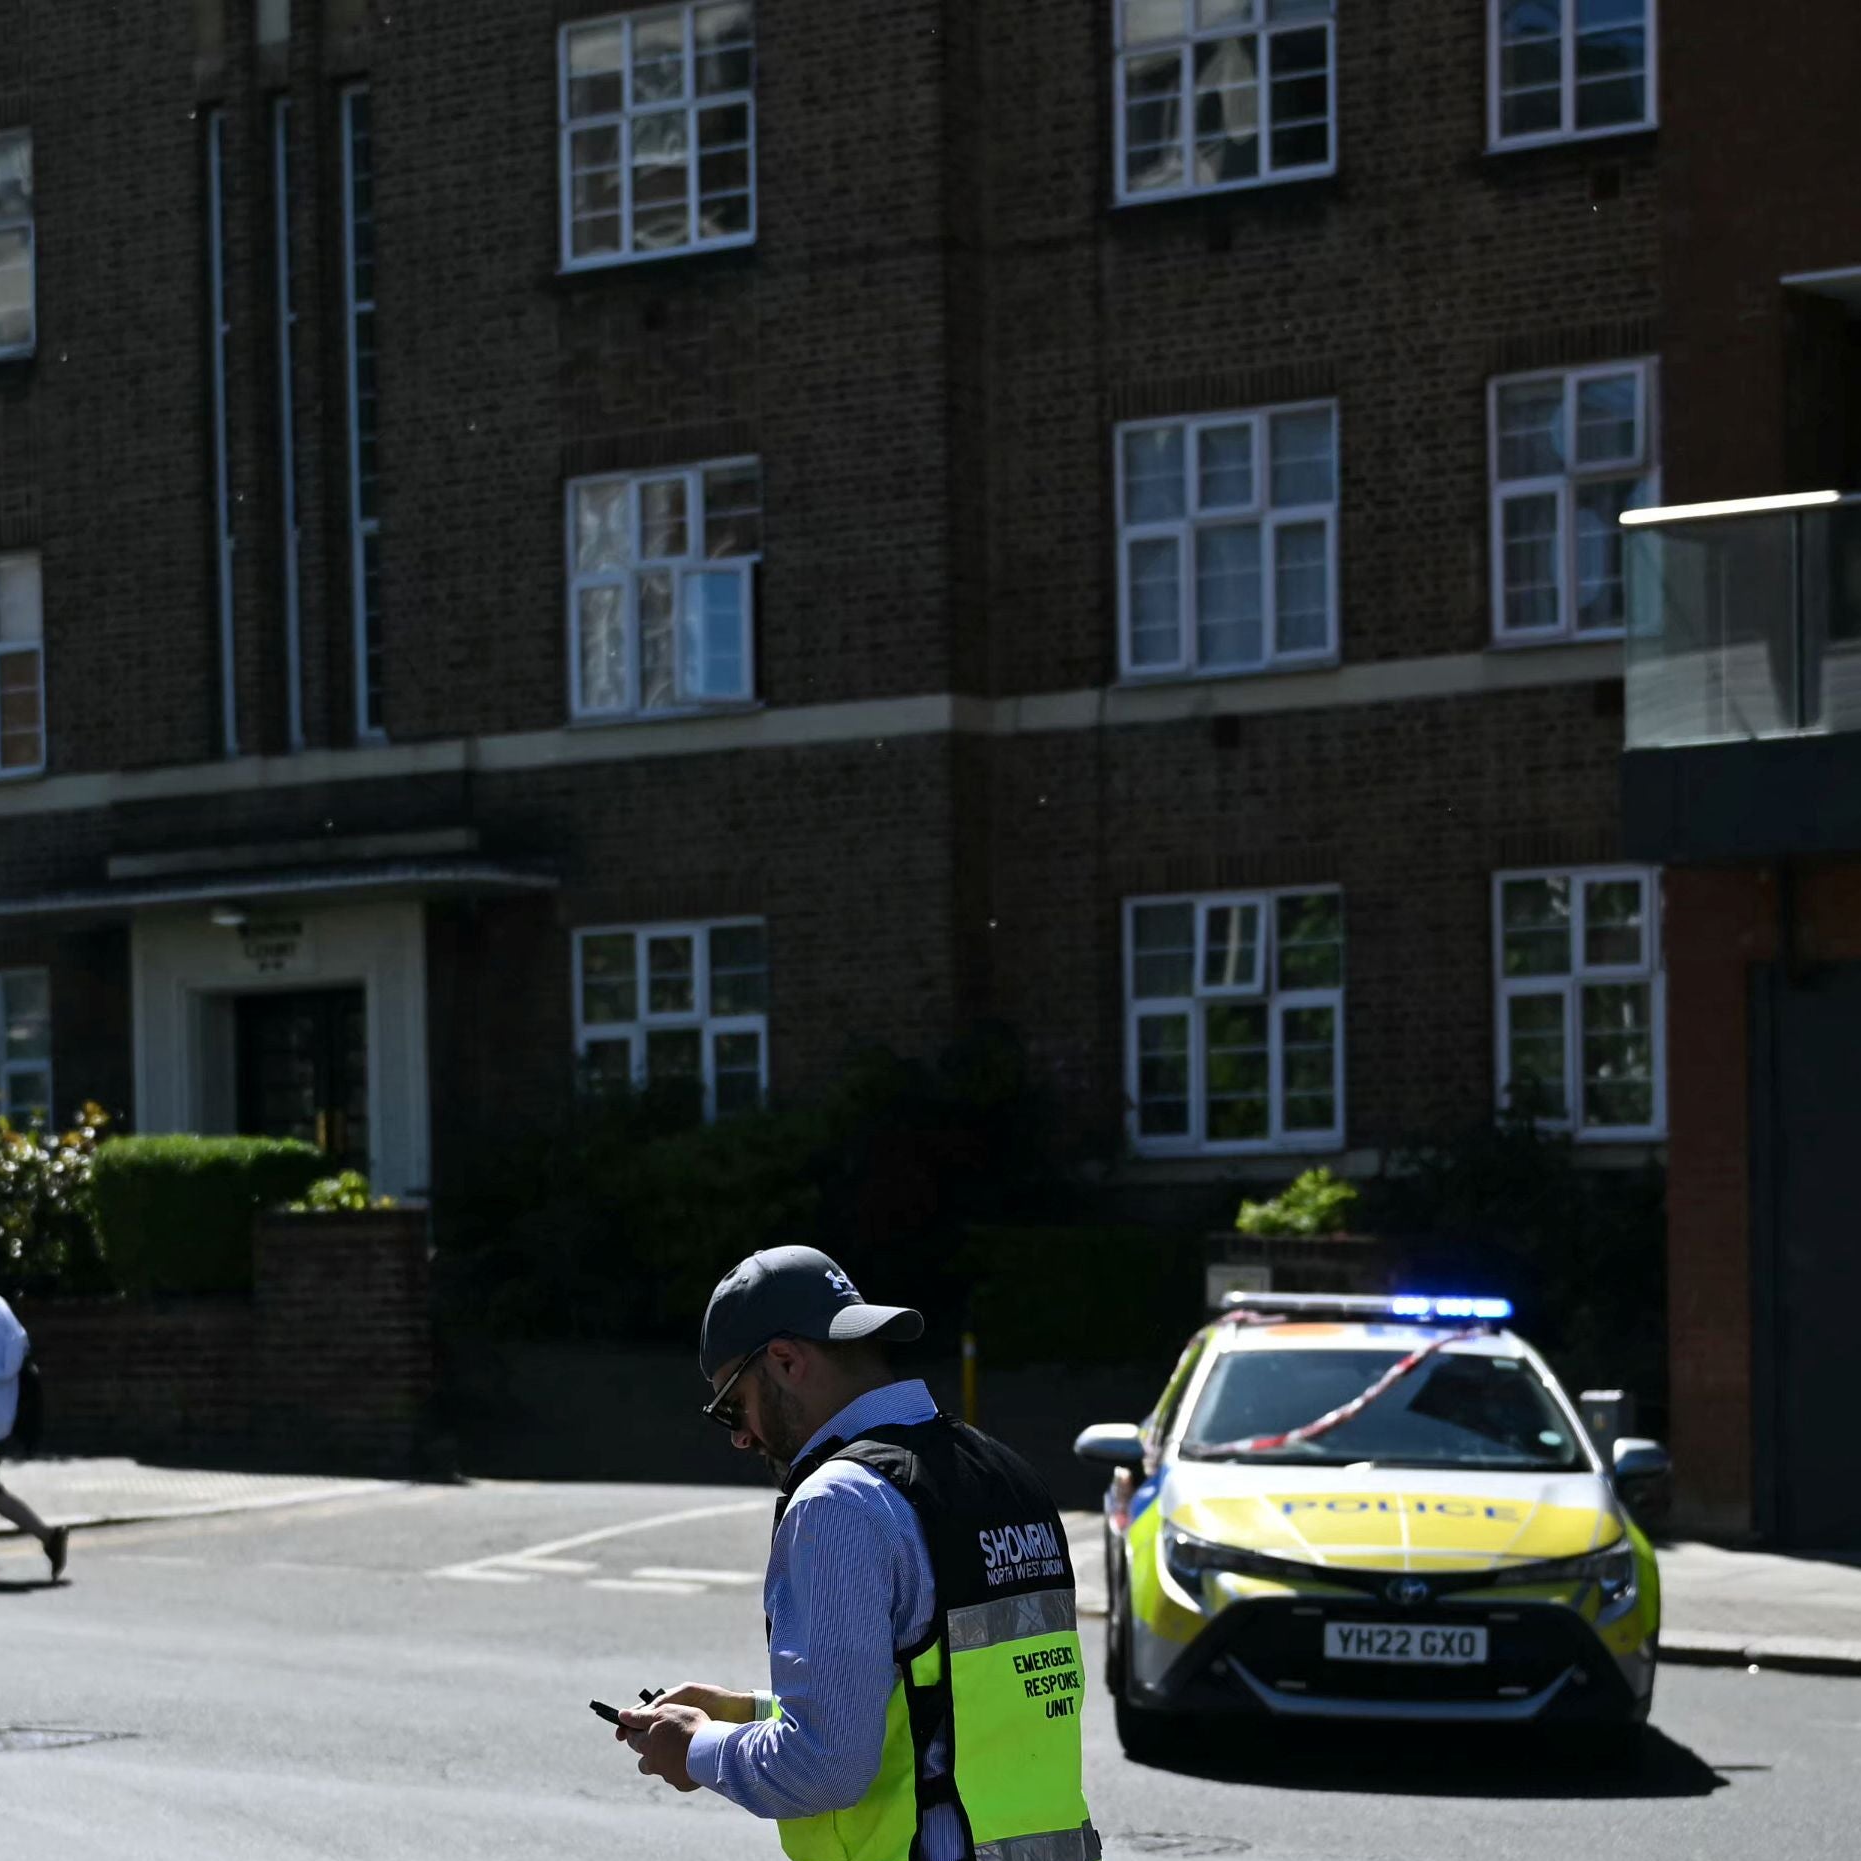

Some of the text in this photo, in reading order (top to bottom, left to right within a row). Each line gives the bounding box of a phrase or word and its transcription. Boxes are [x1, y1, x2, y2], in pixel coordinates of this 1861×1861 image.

[1283, 1499, 1519, 1522] POLICE
[979, 1522, 1061, 1569] SHOMRIM
[986, 1567, 1014, 1586] NORTH
[1015, 1561, 1041, 1581] WEST
[1337, 1627, 1476, 1658] YH22 GXO
[1024, 1670, 1081, 1698] RESPONSE
[1045, 1696, 1075, 1719] UNIT
